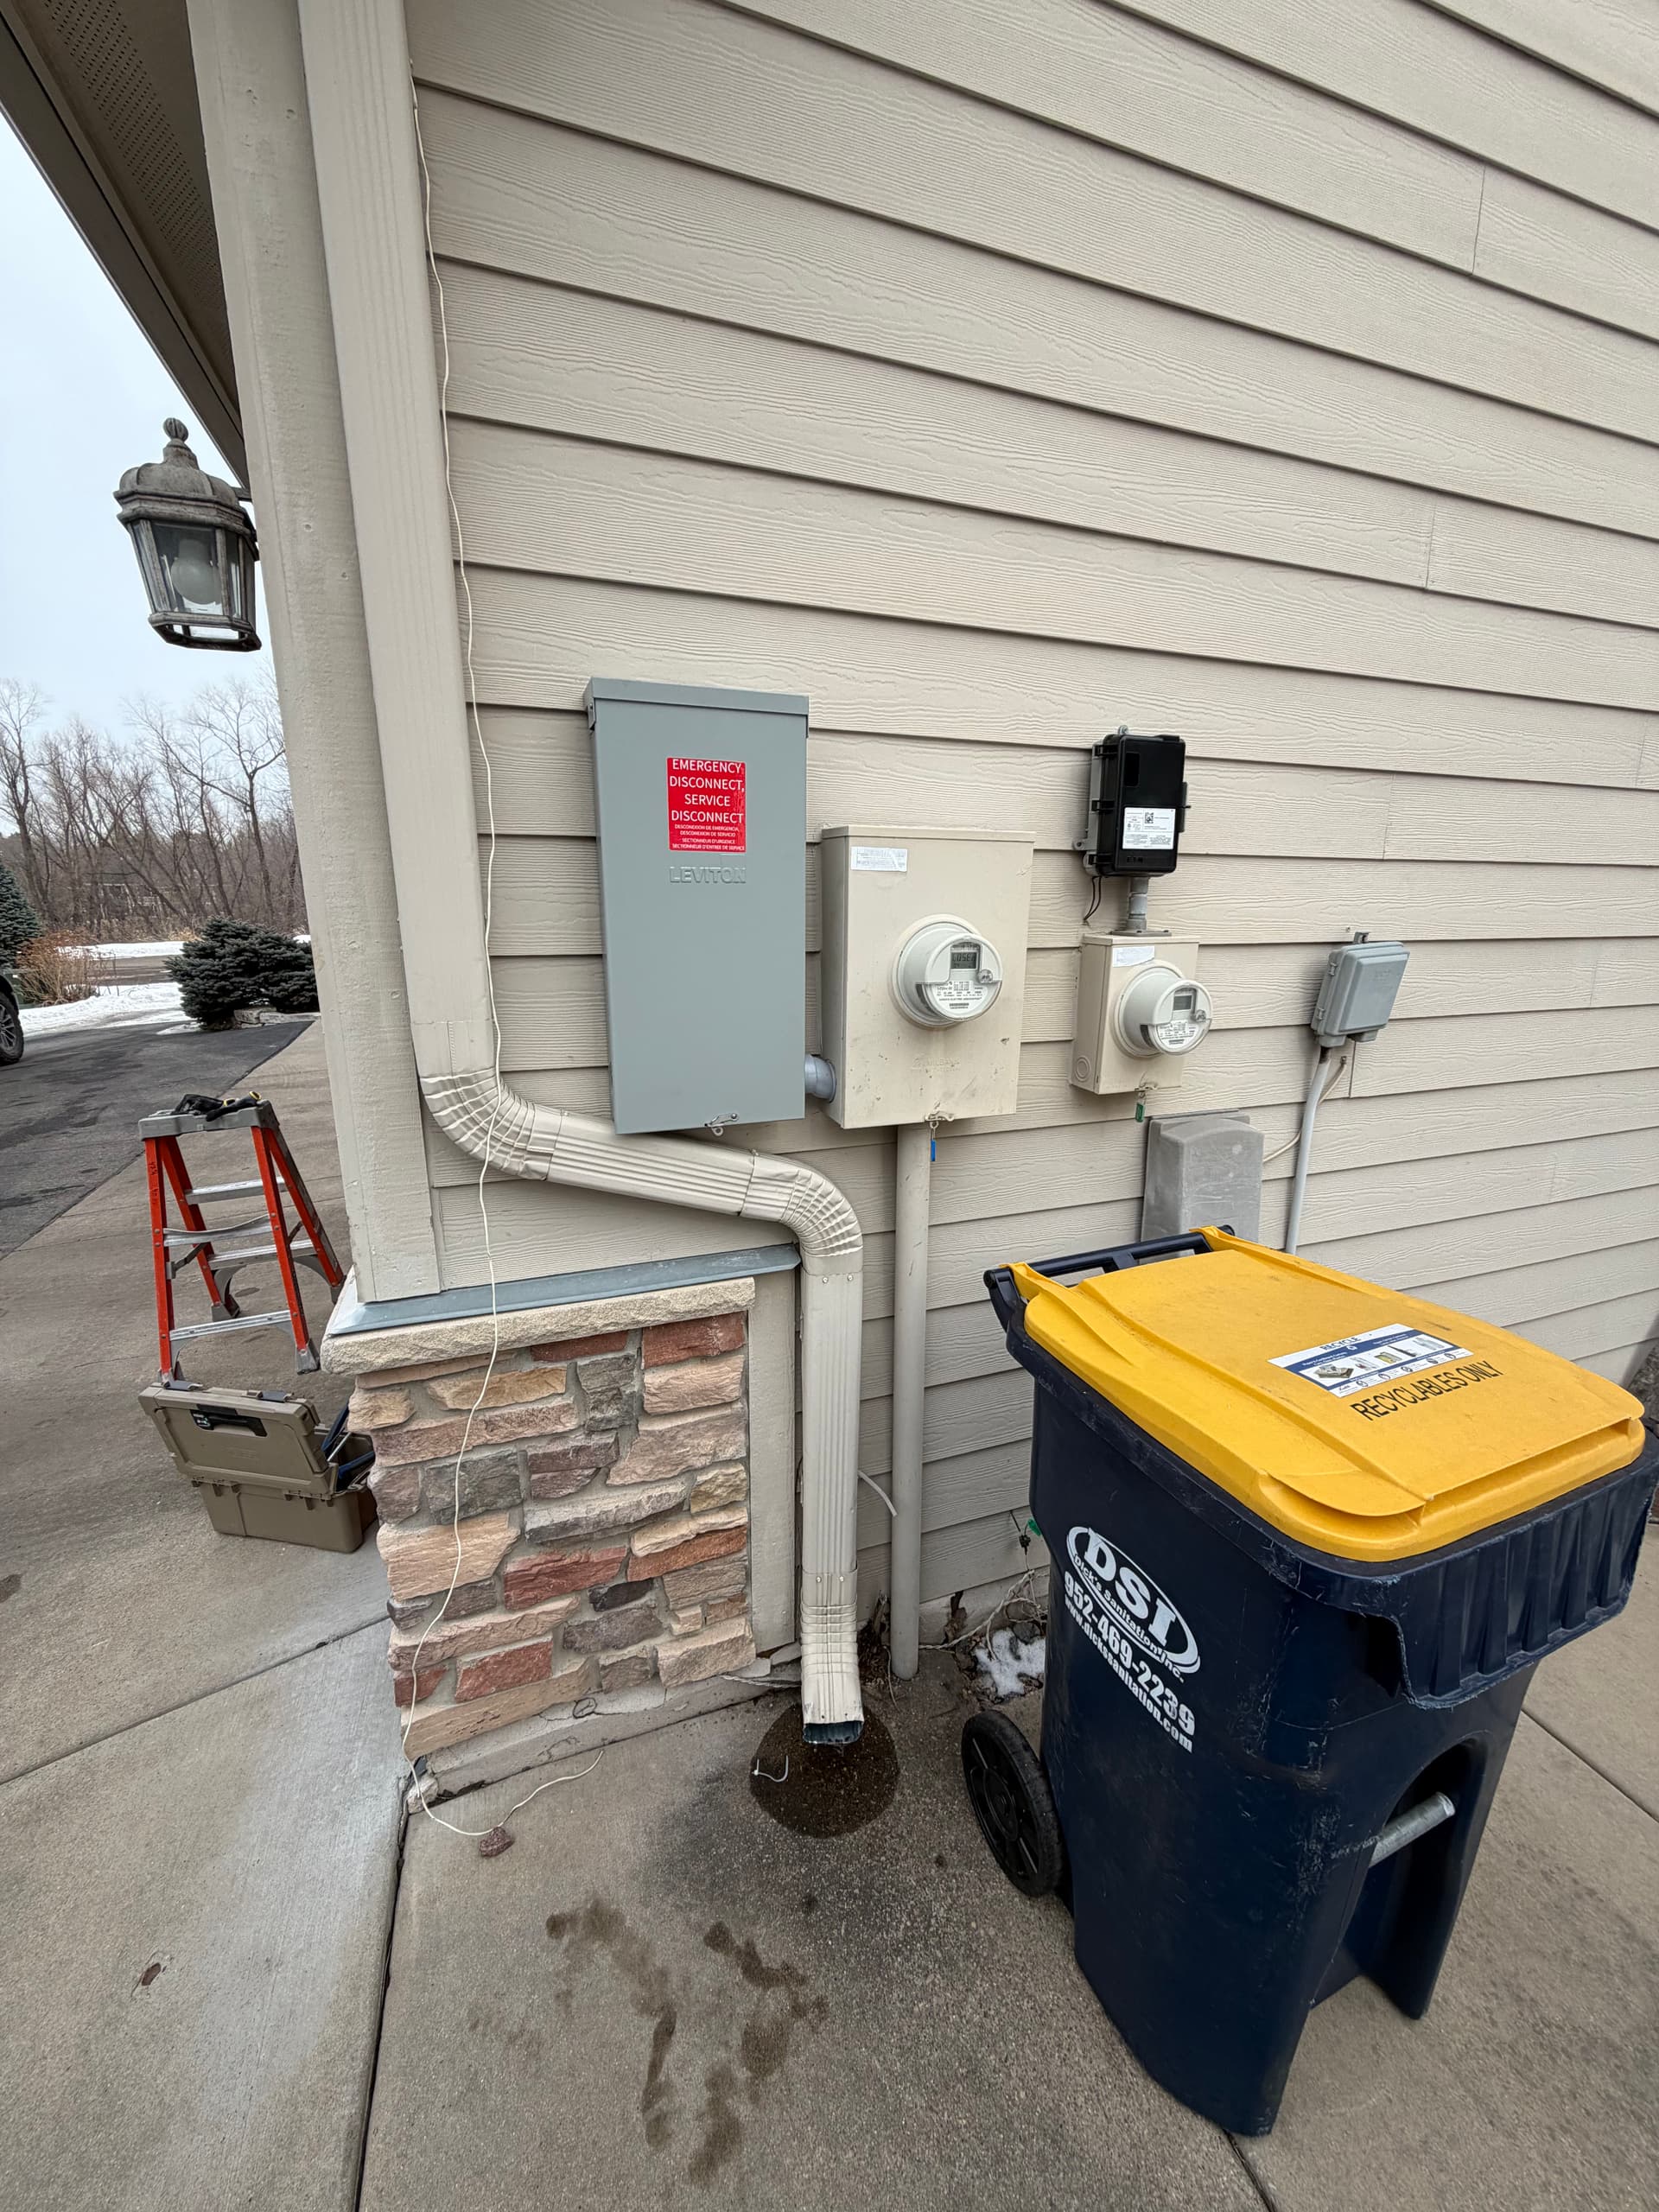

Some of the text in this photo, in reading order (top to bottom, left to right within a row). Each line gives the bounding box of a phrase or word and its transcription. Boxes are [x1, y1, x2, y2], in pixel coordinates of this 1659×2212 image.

[672, 759, 741, 774] EMERGENCY
[670, 776, 745, 792] DISCONNECT,
[684, 793, 731, 806] SERVICE
[671, 810, 744, 823] DISCONNECT
[670, 866, 747, 883] LEVITON
[1320, 1337, 1362, 1351] RECYCLE
[1350, 1360, 1503, 1421] RECYCLABLES ONLY
[1074, 1554, 1102, 1592] Dick's
[1084, 1527, 1177, 1647] DSI
[1065, 1571, 1196, 1736] 952-469-2239
[1065, 1593, 1192, 1754] www.dickssanitation.com
